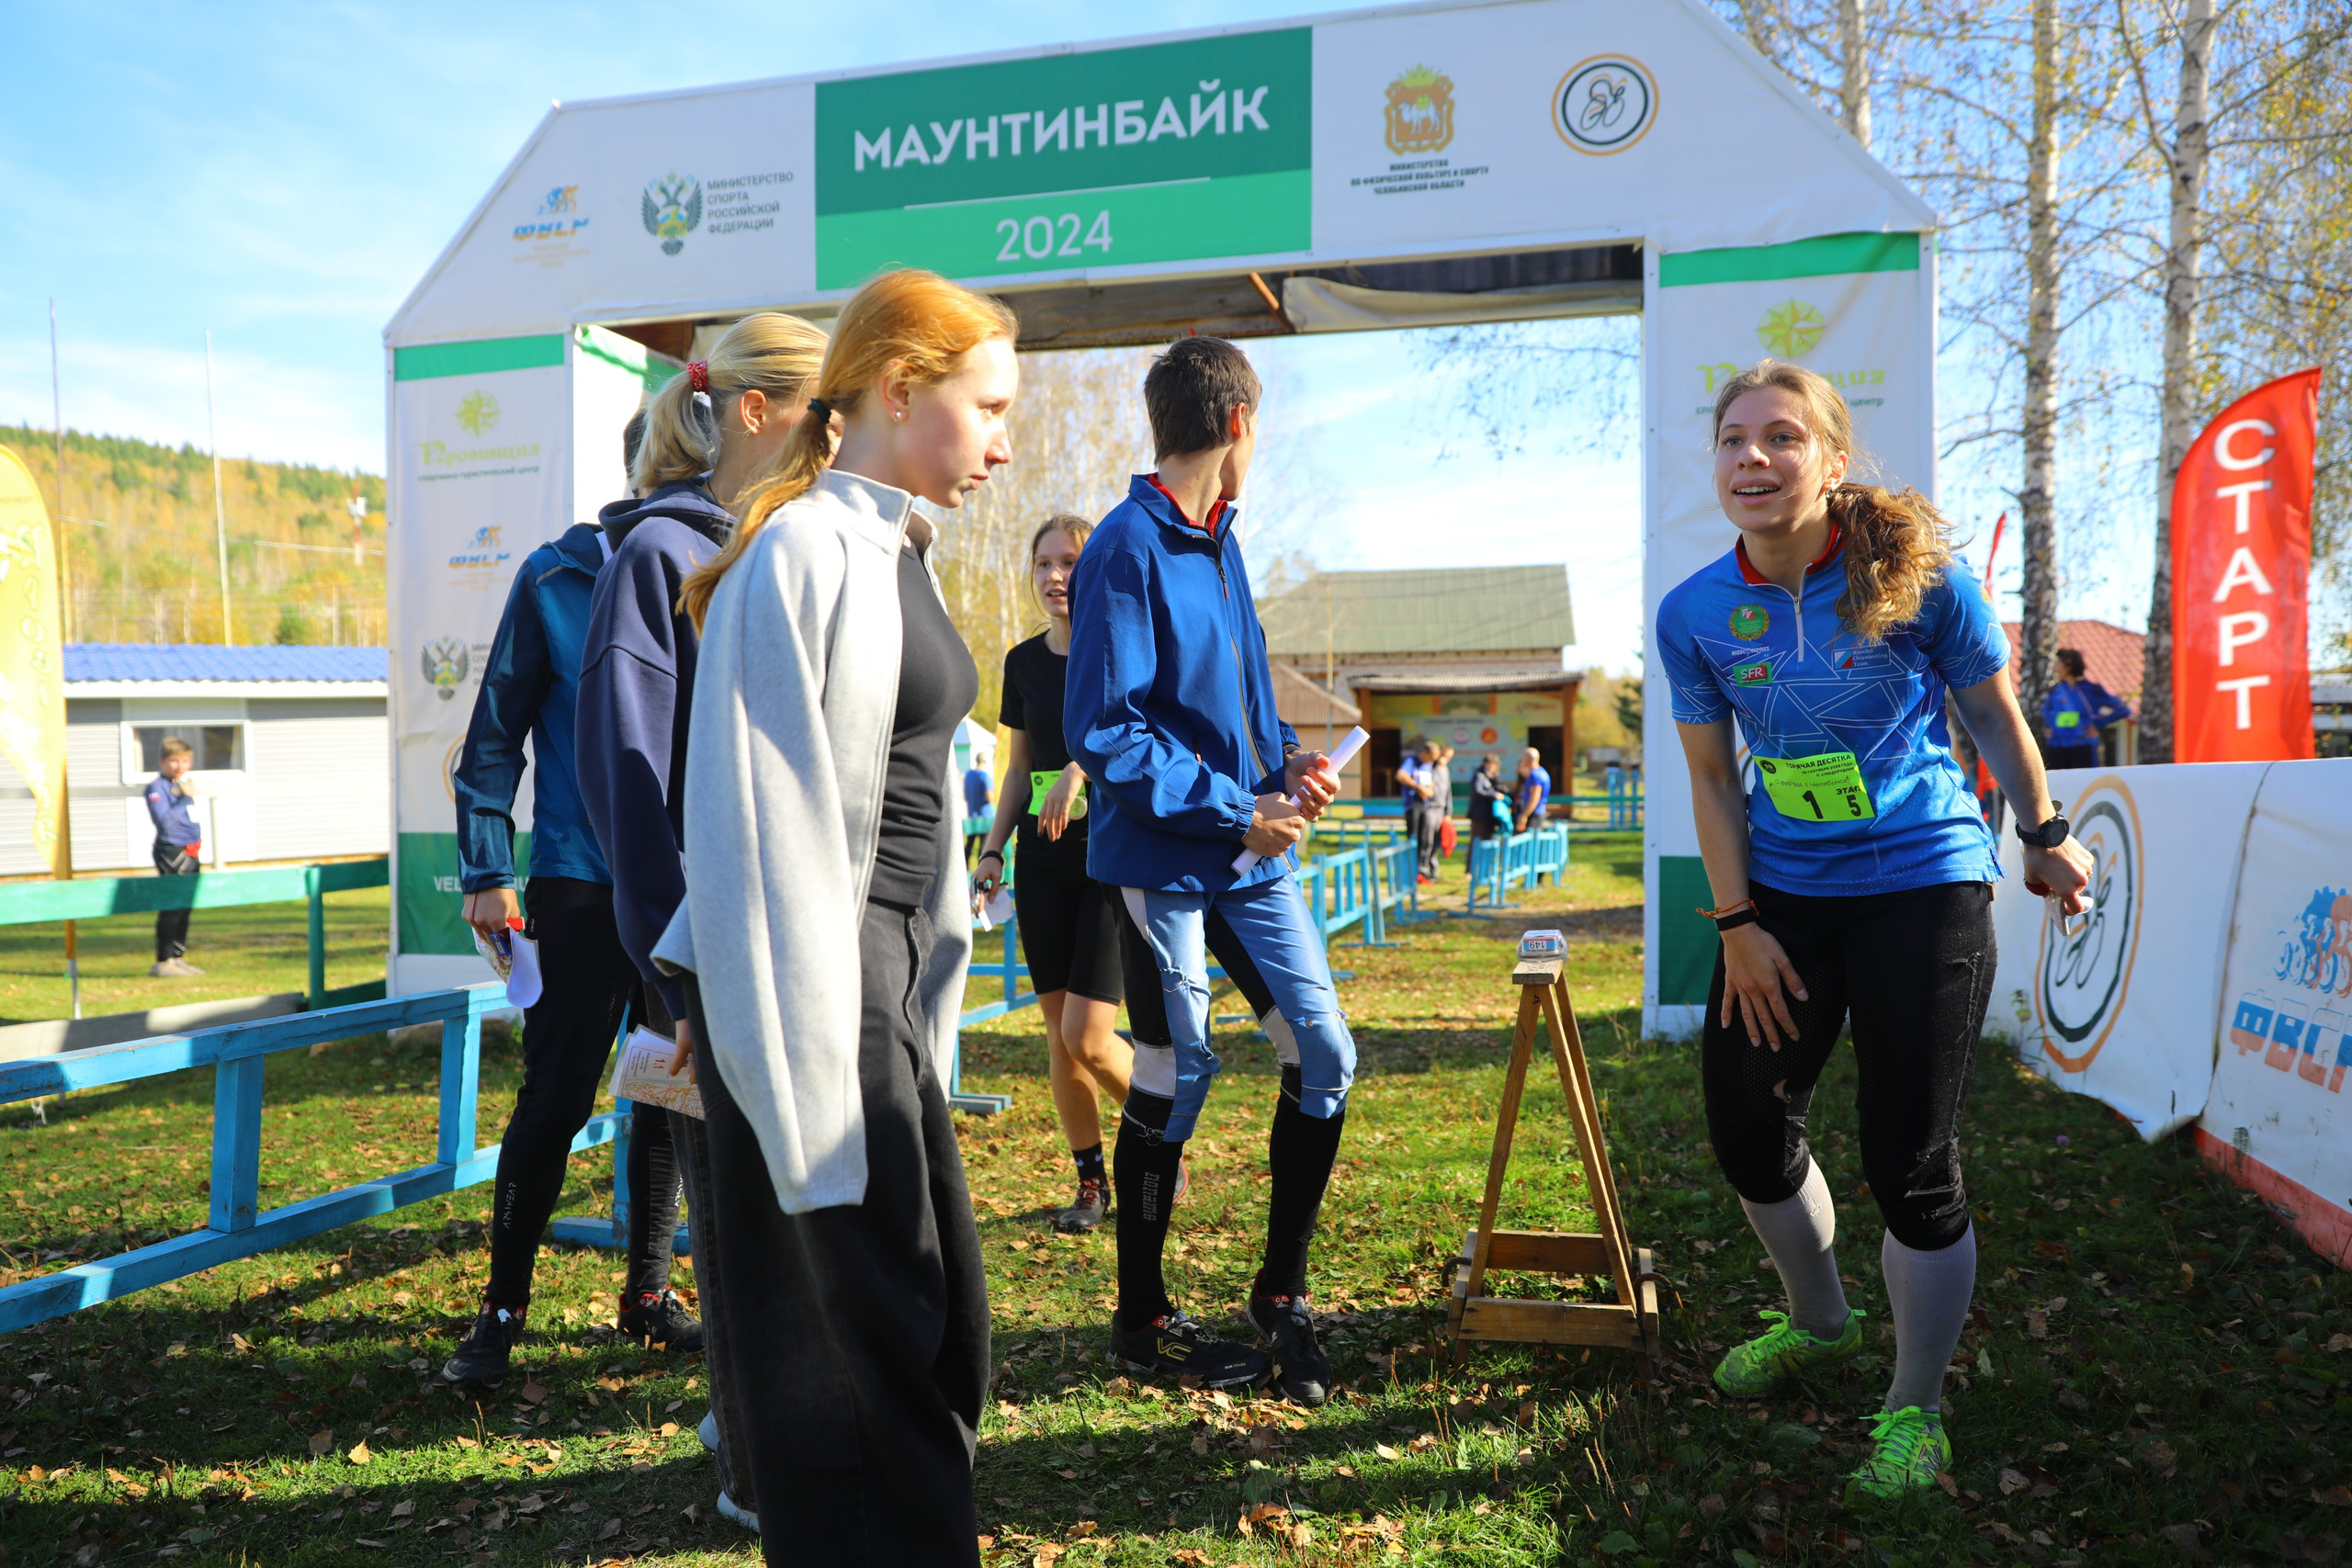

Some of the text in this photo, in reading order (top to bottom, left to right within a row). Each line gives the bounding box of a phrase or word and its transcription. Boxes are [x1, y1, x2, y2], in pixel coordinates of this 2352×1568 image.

[854, 78, 1270, 172] МАУНТИНБАЙК
[707, 172, 794, 190] МИНИСТЕРСТВО
[707, 191, 749, 204] СПОРТА
[707, 199, 780, 219] РОССИЙСКОЙ
[708, 218, 774, 233] ФЕДЕРАЦИИ
[996, 209, 1113, 262] 2024
[2212, 418, 2277, 731] СТАРТ
[1852, 652, 1888, 661] Orienteering
[1740, 667, 1763, 680] SFR
[1816, 754, 1851, 767] ДЕСЯТКА
[1836, 785, 1860, 795] ЭТАП
[1803, 790, 1824, 818] 1
[1846, 795, 1861, 817] 5
[1529, 941, 1545, 949] 149
